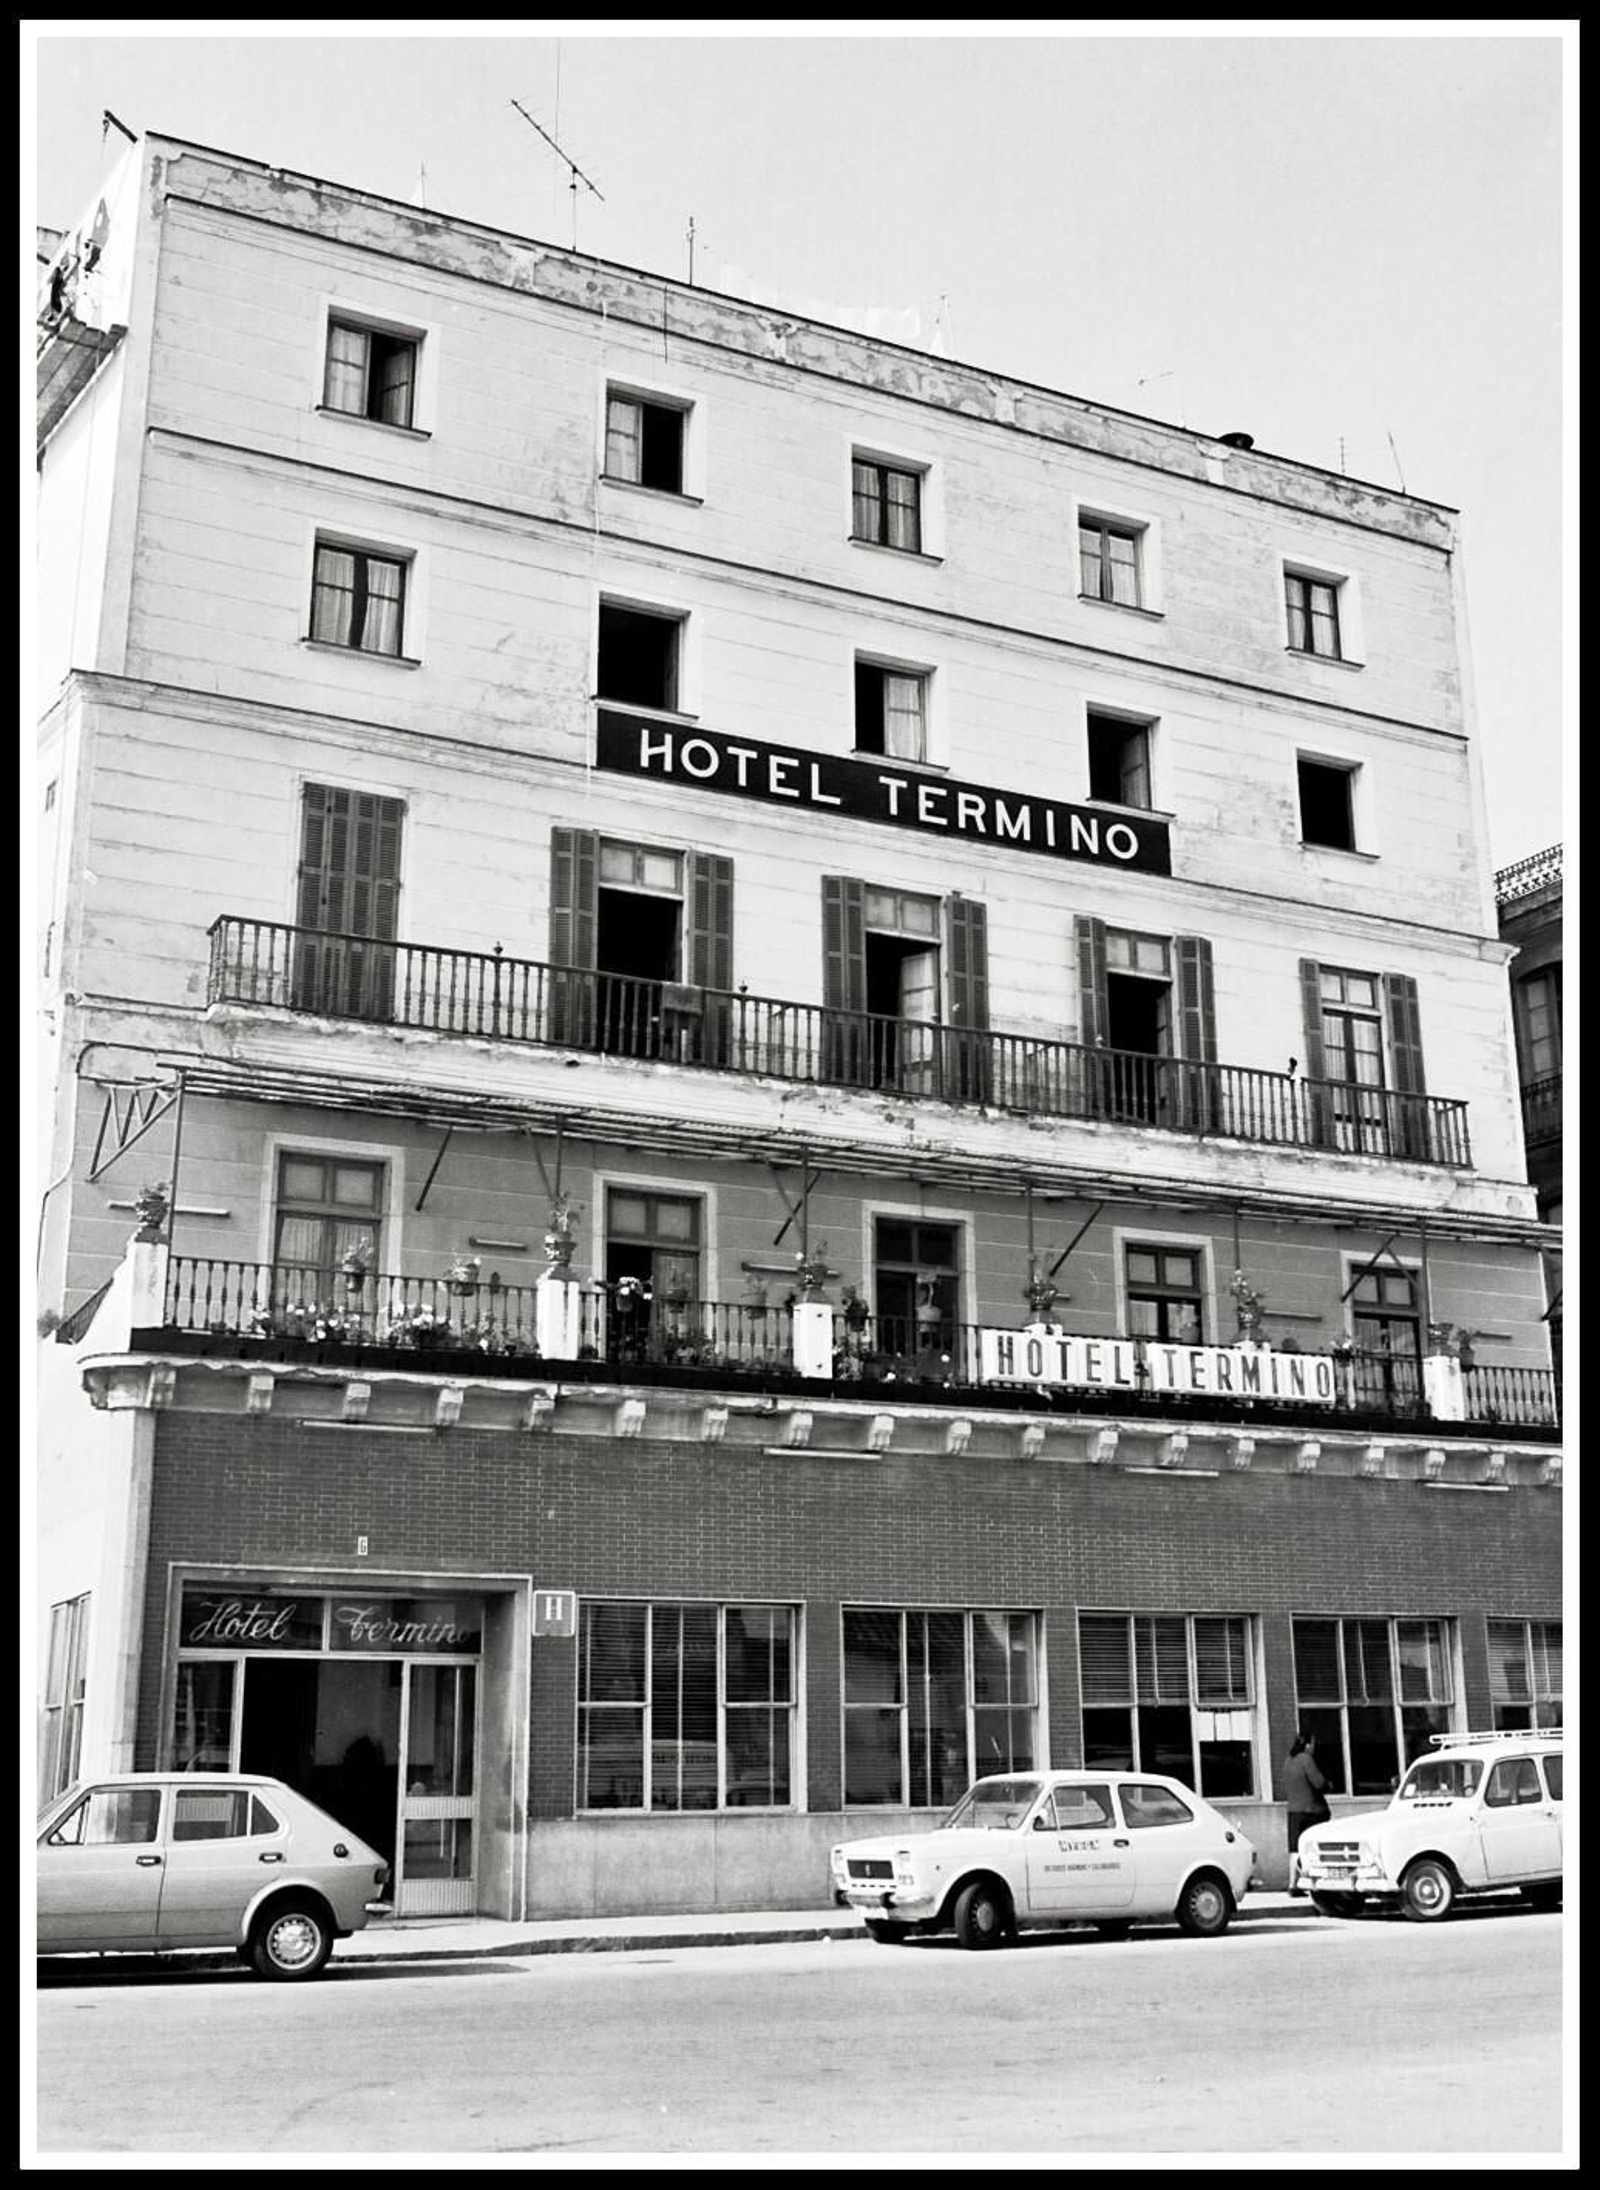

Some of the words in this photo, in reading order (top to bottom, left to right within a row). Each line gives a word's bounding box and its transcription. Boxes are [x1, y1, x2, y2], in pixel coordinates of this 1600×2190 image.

[640, 729, 841, 805] HOTEL
[879, 777, 1139, 860] TERMINO
[998, 1335, 1131, 1385] HOTEL
[1162, 1348, 1331, 1398] TERMINO
[190, 1601, 297, 1642] Hotel
[545, 1597, 566, 1621] H
